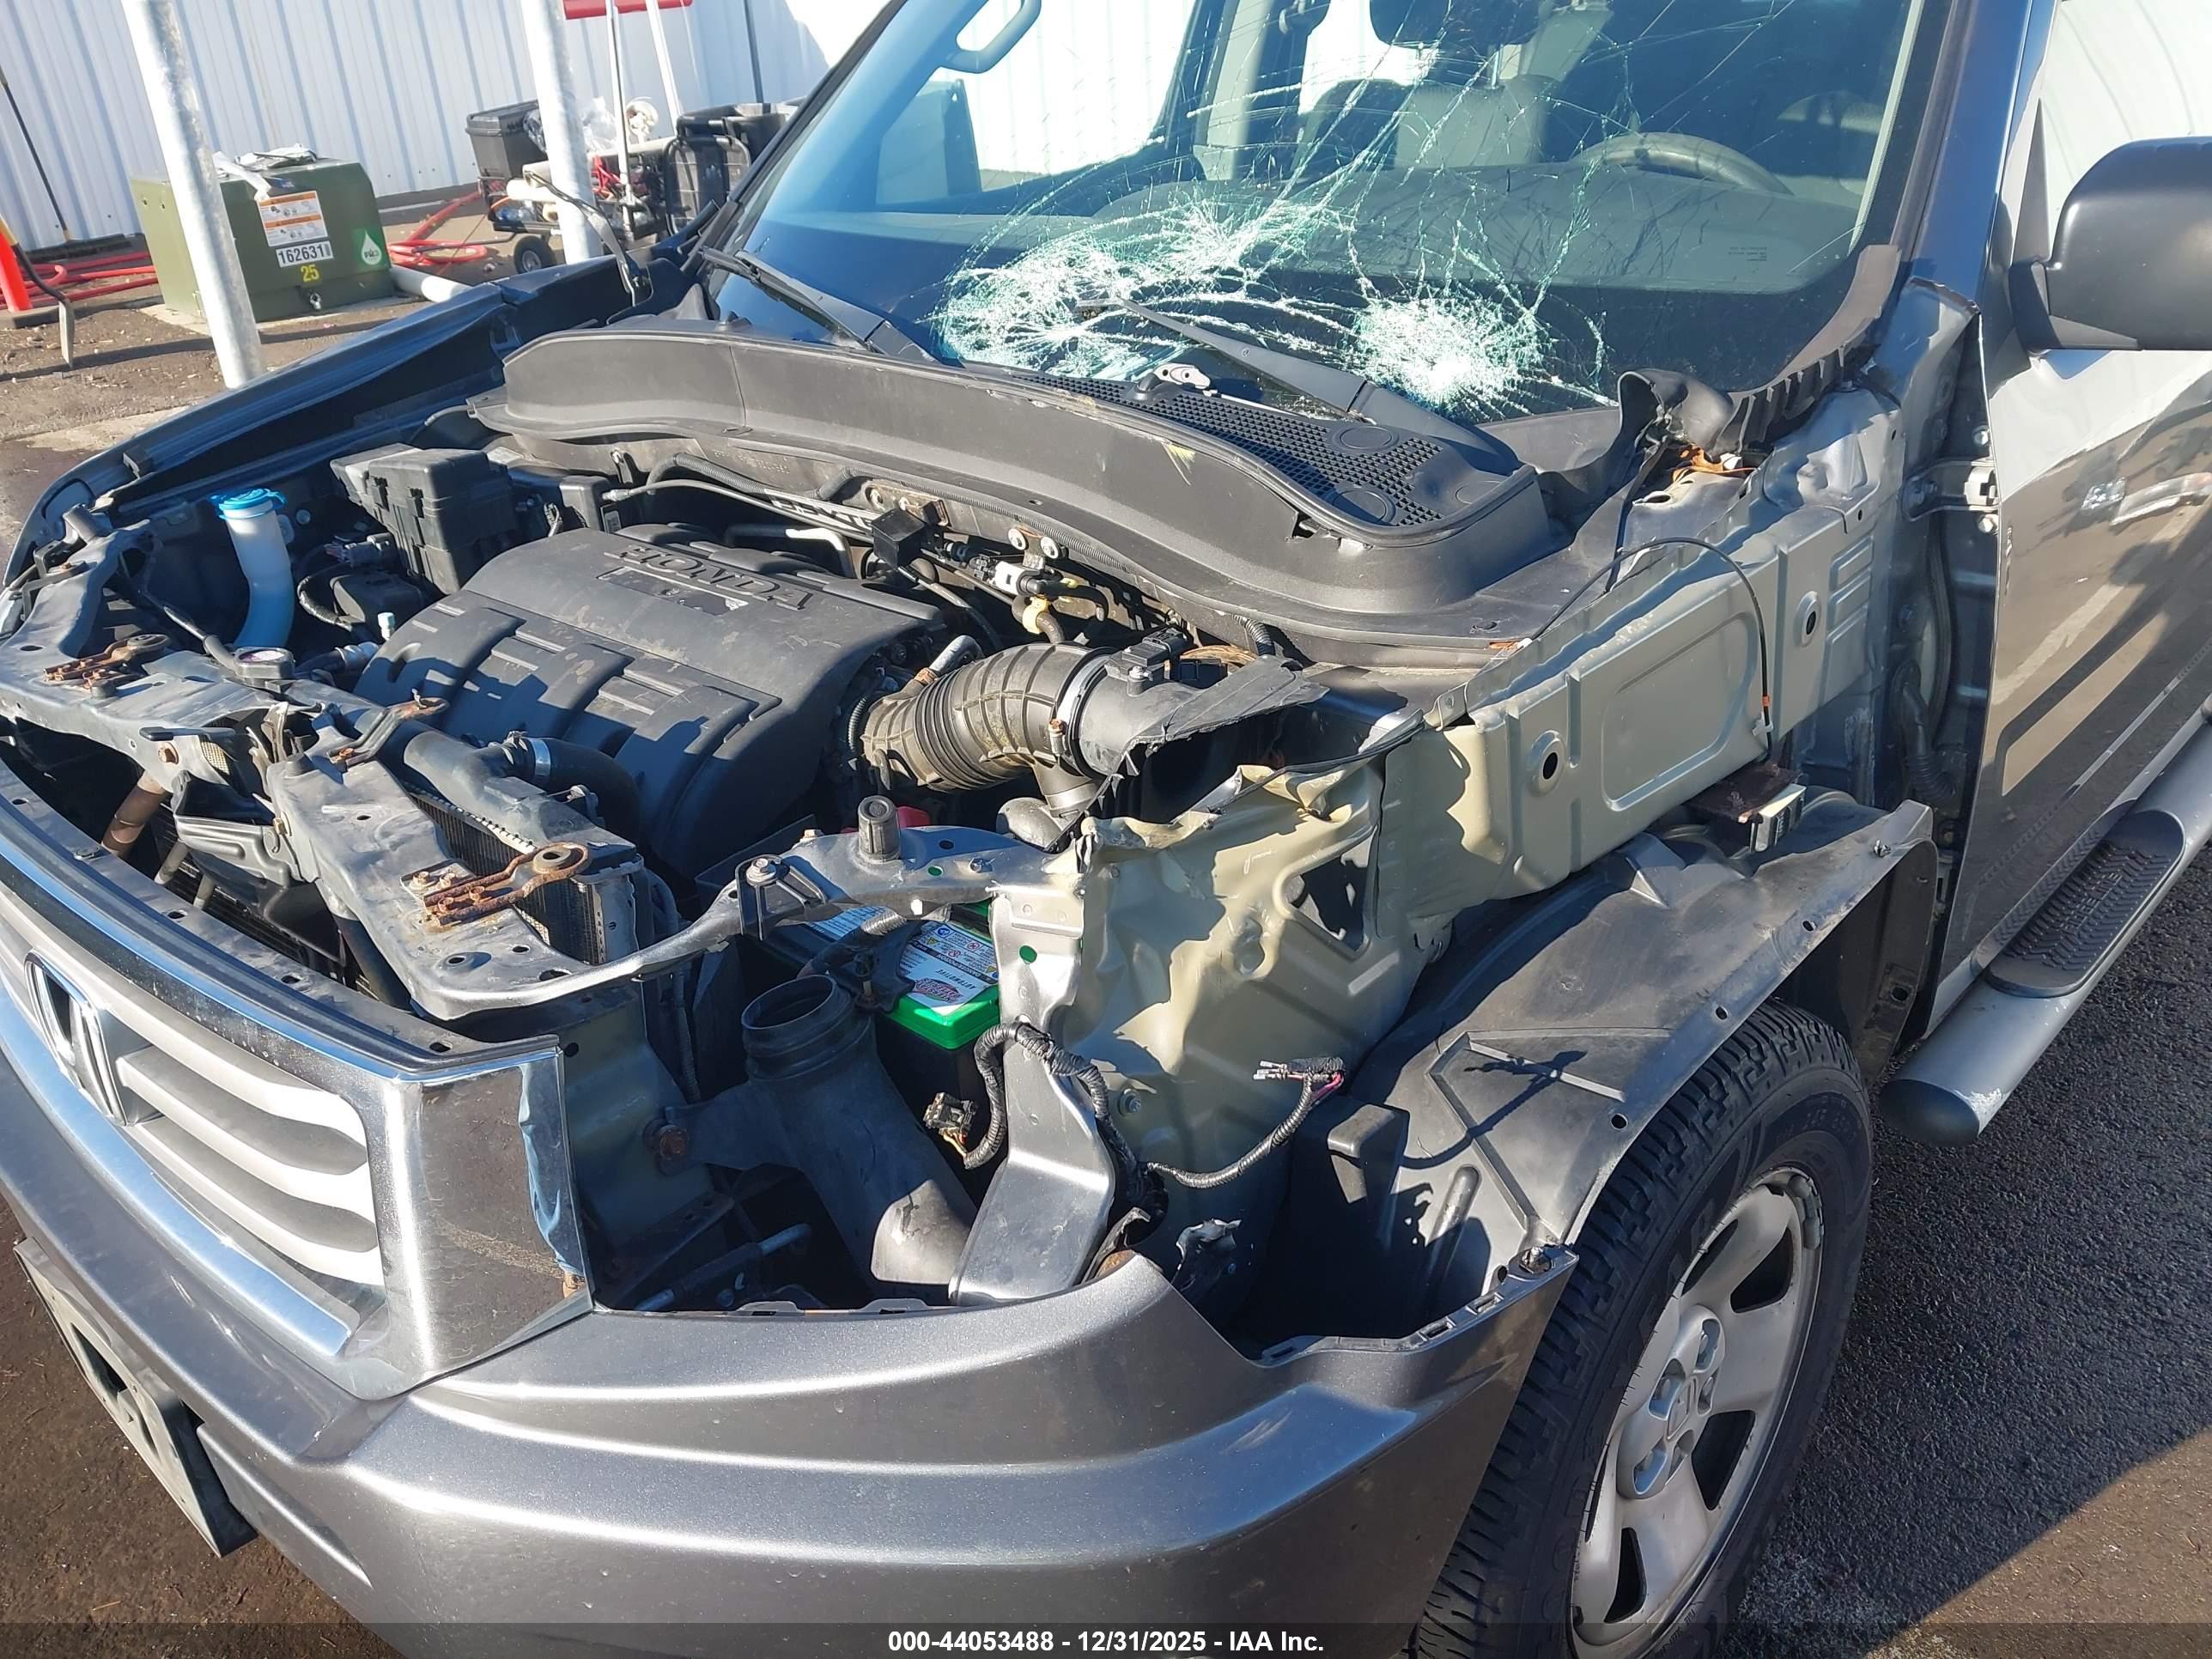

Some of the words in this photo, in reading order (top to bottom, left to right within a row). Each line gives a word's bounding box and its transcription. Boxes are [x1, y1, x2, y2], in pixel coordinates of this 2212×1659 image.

[278, 244, 324, 264] 162631
[301, 264, 319, 282] 25
[604, 544, 813, 611] HONDA
